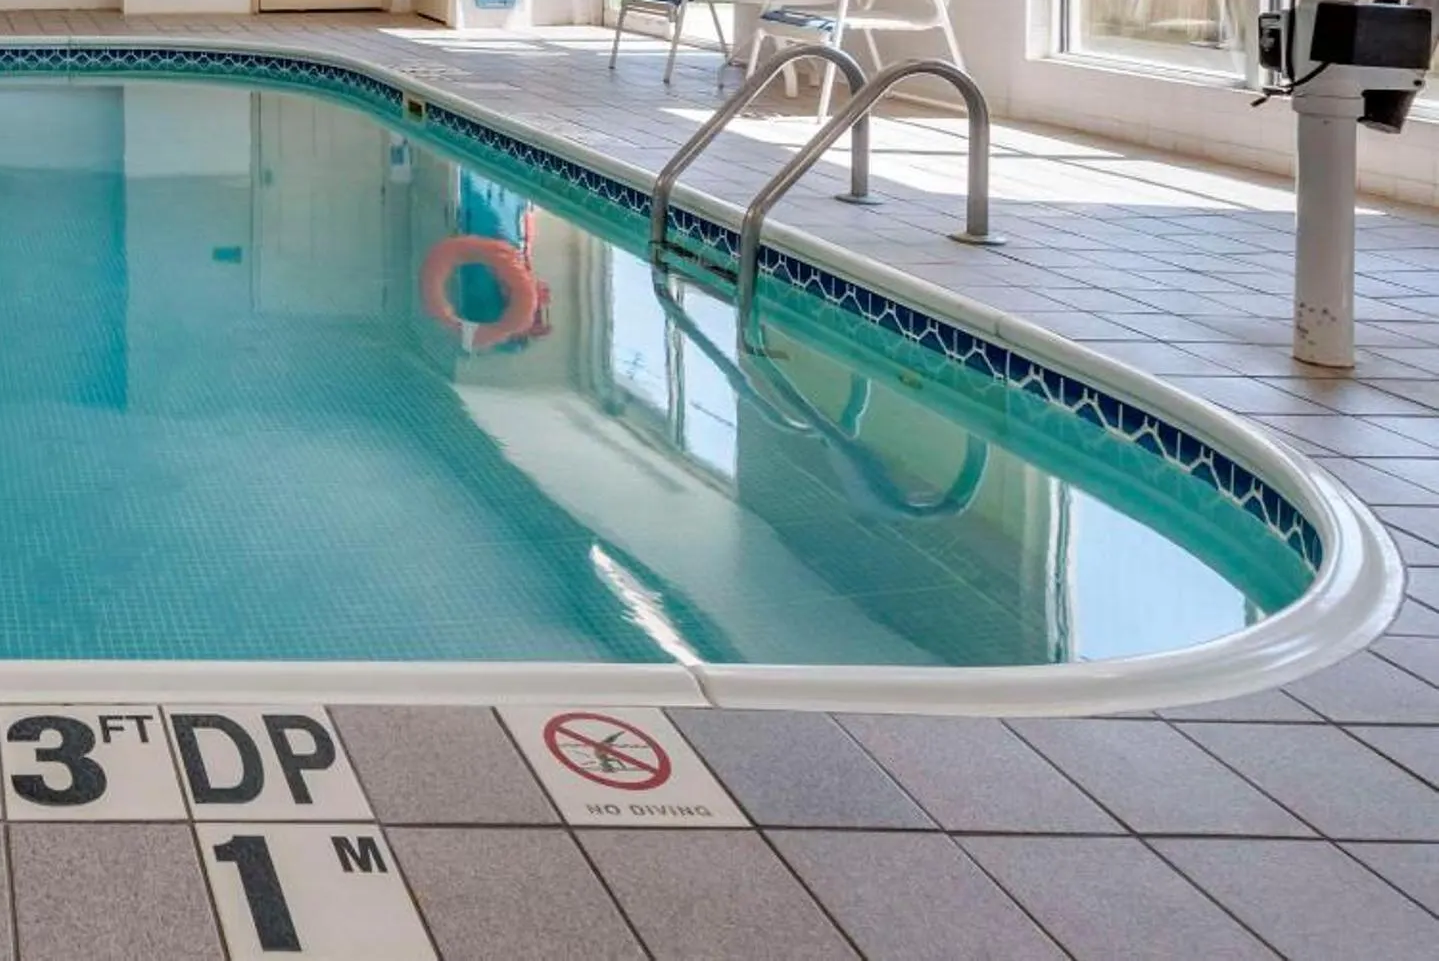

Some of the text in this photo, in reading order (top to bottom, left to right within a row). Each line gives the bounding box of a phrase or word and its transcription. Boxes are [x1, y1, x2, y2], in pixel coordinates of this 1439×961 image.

[170, 713, 336, 805] DP
[586, 803, 713, 817] NO DIVING
